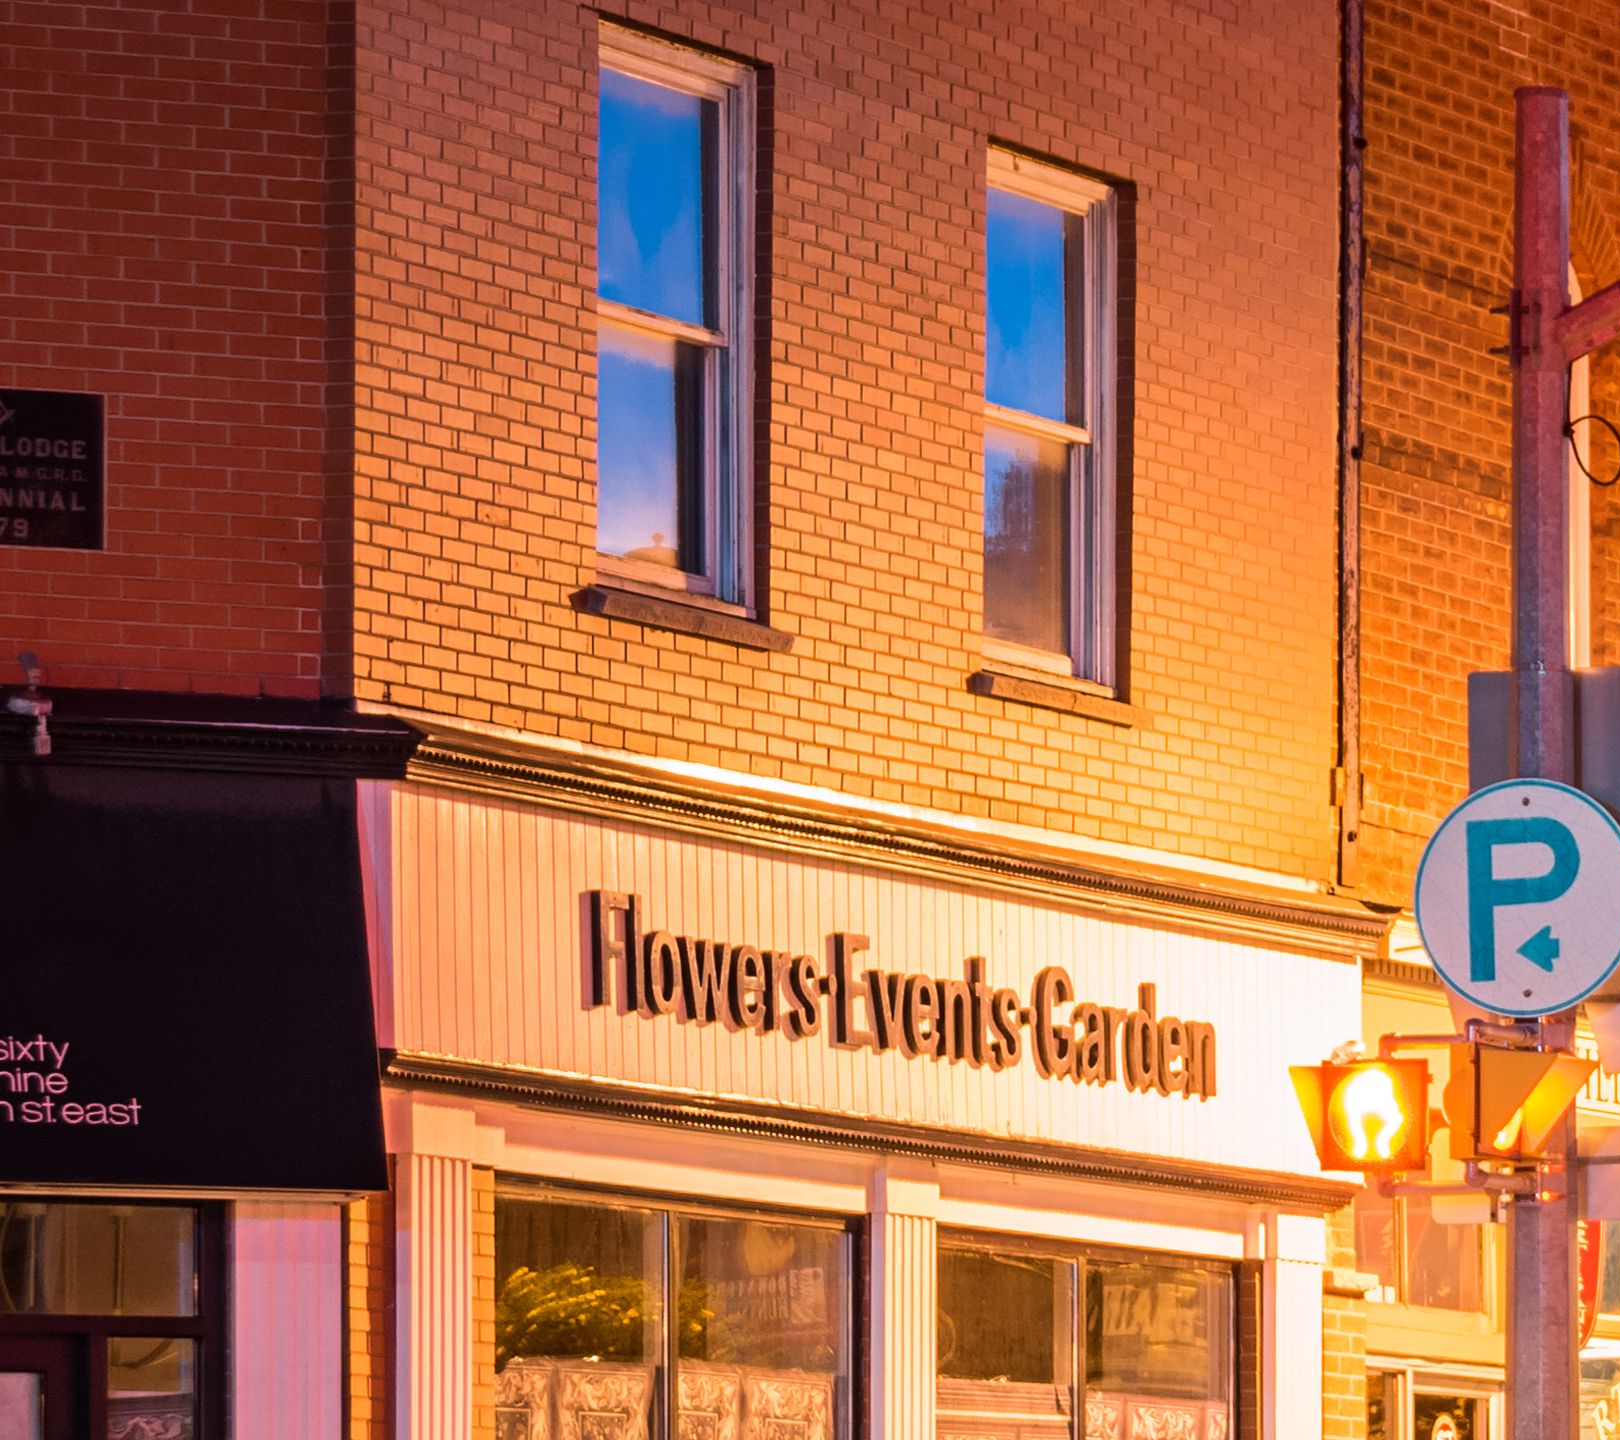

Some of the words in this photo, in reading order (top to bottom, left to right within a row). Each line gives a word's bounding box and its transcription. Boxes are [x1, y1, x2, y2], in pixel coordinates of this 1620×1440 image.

[0, 436, 87, 460] LODGE
[1466, 816, 1581, 982] P
[1032, 964, 1217, 1101] Garden
[0, 1068, 69, 1094] nine
[61, 1097, 142, 1125] east
